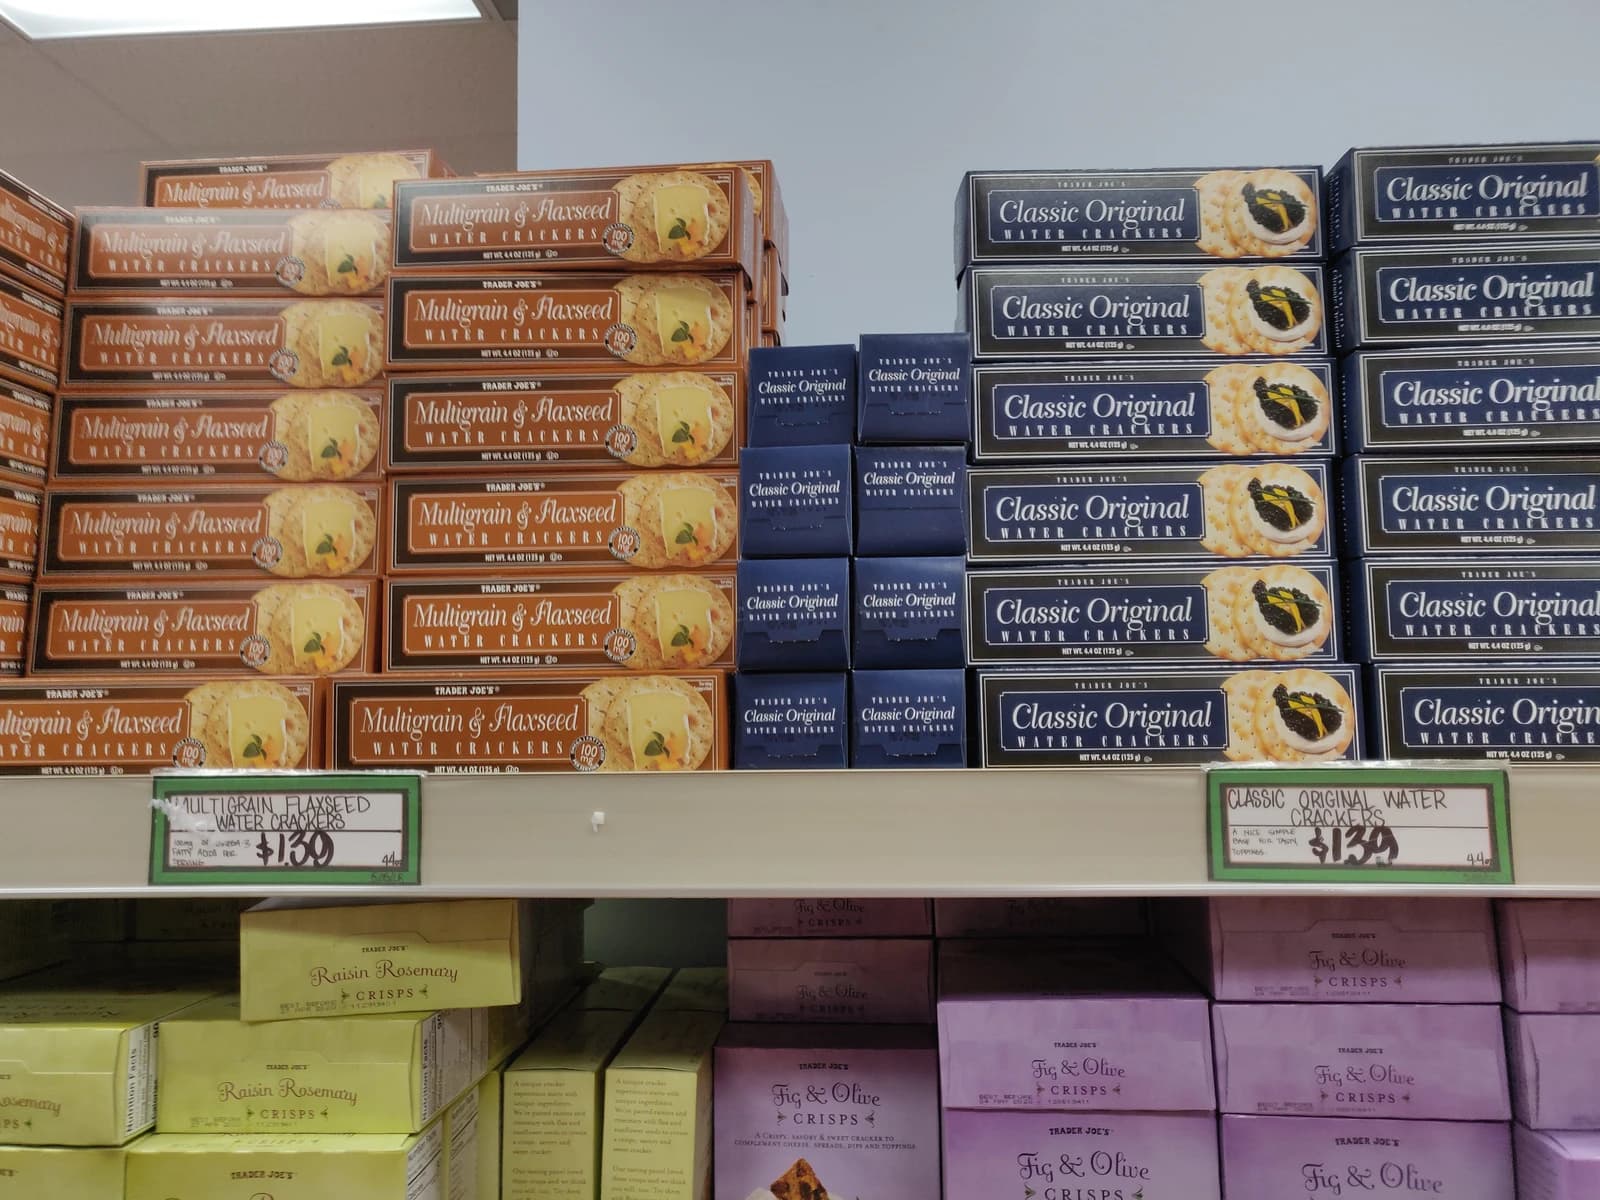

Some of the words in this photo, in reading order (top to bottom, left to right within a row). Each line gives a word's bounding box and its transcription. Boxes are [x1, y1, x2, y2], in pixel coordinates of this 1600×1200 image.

[1387, 177, 1473, 202] Classic
[1479, 172, 1588, 207] Original
[420, 203, 510, 232] Multigrain
[514, 202, 528, 227] &
[531, 197, 611, 222] Flaxseed
[1000, 200, 1079, 223] Classic
[1086, 198, 1184, 229] Original
[103, 229, 188, 261] Multigrain
[208, 229, 287, 255] Flaxseed
[1390, 277, 1477, 302] Classic
[1483, 272, 1594, 307] Original
[415, 298, 508, 329] Multigrain
[513, 298, 529, 325] &
[531, 295, 613, 321] Flaxseed
[1002, 296, 1083, 319] Classic
[1089, 294, 1190, 326] Original
[759, 381, 796, 394] Classic
[799, 379, 847, 395] Original
[869, 369, 908, 381] Classic
[910, 368, 960, 384] Original
[1393, 381, 1482, 406] Classic
[1489, 376, 1600, 411] Original
[415, 400, 508, 431] Multigrain
[513, 400, 528, 427] &
[531, 396, 613, 422] Flaxseed
[1004, 394, 1086, 418] Classic
[1093, 393, 1195, 425] Original
[81, 415, 170, 446] Multigrain
[191, 413, 269, 439] Flaxseed
[750, 484, 788, 497] Classic
[791, 481, 840, 498] Original
[864, 473, 903, 485] Classic
[906, 472, 955, 488] Original
[996, 497, 1078, 521] Classic
[1085, 494, 1189, 527] Original
[1393, 486, 1479, 512] Classic
[1486, 484, 1596, 519] Original
[418, 501, 511, 533] Multigrain
[516, 502, 532, 529] &
[534, 497, 616, 524] Flaxseed
[747, 597, 786, 610] Classic
[789, 594, 838, 611] Original
[997, 599, 1079, 624] Classic
[1087, 597, 1192, 631] Original
[1400, 592, 1486, 617] Classic
[1493, 590, 1600, 625] Original
[59, 609, 150, 640] Multigrain
[154, 611, 169, 637] &
[172, 607, 250, 632] Flaxseed
[414, 602, 507, 634] Multigrain
[512, 603, 527, 632] &
[530, 599, 612, 625] Flaxseed
[434, 686, 468, 695] TRADER
[470, 686, 495, 695] JOE'S
[0, 707, 72, 743] ultigrain
[76, 710, 94, 741] &
[96, 705, 183, 735] Flaxseed
[360, 706, 463, 741] Multigrain
[468, 707, 485, 738] &
[488, 702, 579, 732] Flaxseed
[745, 710, 783, 723] Classic
[786, 709, 835, 725] Original
[862, 708, 902, 721] Classic
[904, 707, 955, 724] Original
[1012, 703, 1098, 729] Classic
[1105, 701, 1212, 737] Original
[1415, 699, 1505, 725] Classic
[1512, 698, 1600, 734] Origin
[373, 741, 437, 756] WATER
[456, 741, 563, 755] CRACKERS
[581, 743, 598, 758] 100
[1018, 735, 1083, 748] WATER
[1102, 734, 1209, 747] CRACKERS
[175, 796, 273, 815] MULTIGRAIN
[286, 796, 371, 815] FLAXSEED
[1228, 789, 1286, 810] CLASSIC
[1298, 789, 1375, 809] ORIGINAL
[1384, 789, 1448, 810] WATER
[215, 813, 264, 832] WATER
[271, 814, 345, 831] CRACKERS
[1291, 808, 1385, 828] CRACKERS
[1308, 949, 1335, 971] Fig
[1338, 950, 1358, 968] &
[1361, 949, 1407, 969] Olive
[310, 966, 370, 987] Raisin
[375, 959, 458, 983] Rosemary
[1328, 977, 1388, 988] CRISPS
[356, 988, 415, 1000] CRISPS
[1031, 1059, 1057, 1080] Fig
[1060, 1059, 1080, 1077] &
[1082, 1057, 1125, 1078] Olive
[1314, 1064, 1343, 1087] Fig
[1346, 1065, 1366, 1083] &
[1369, 1063, 1416, 1086] Olive
[217, 1082, 274, 1102] Raisin
[279, 1078, 359, 1107] Rosemary
[772, 1084, 802, 1108] Fig
[806, 1083, 828, 1105] &
[832, 1081, 881, 1107] Olive
[1050, 1085, 1107, 1096] CRISPS
[1335, 1091, 1396, 1104] CRISPS
[260, 1109, 316, 1119] CRISPS
[793, 1113, 859, 1126] CRISPS
[1049, 1127, 1083, 1135] TRADER
[1335, 1137, 1371, 1147] TRADER
[231, 1171, 265, 1180] TRADER
[1017, 1152, 1054, 1183] Fig
[1058, 1153, 1086, 1178] &
[1090, 1150, 1151, 1180] Olive
[1302, 1163, 1342, 1195] Fig
[1346, 1163, 1374, 1191] &
[1380, 1162, 1443, 1194] Olive
